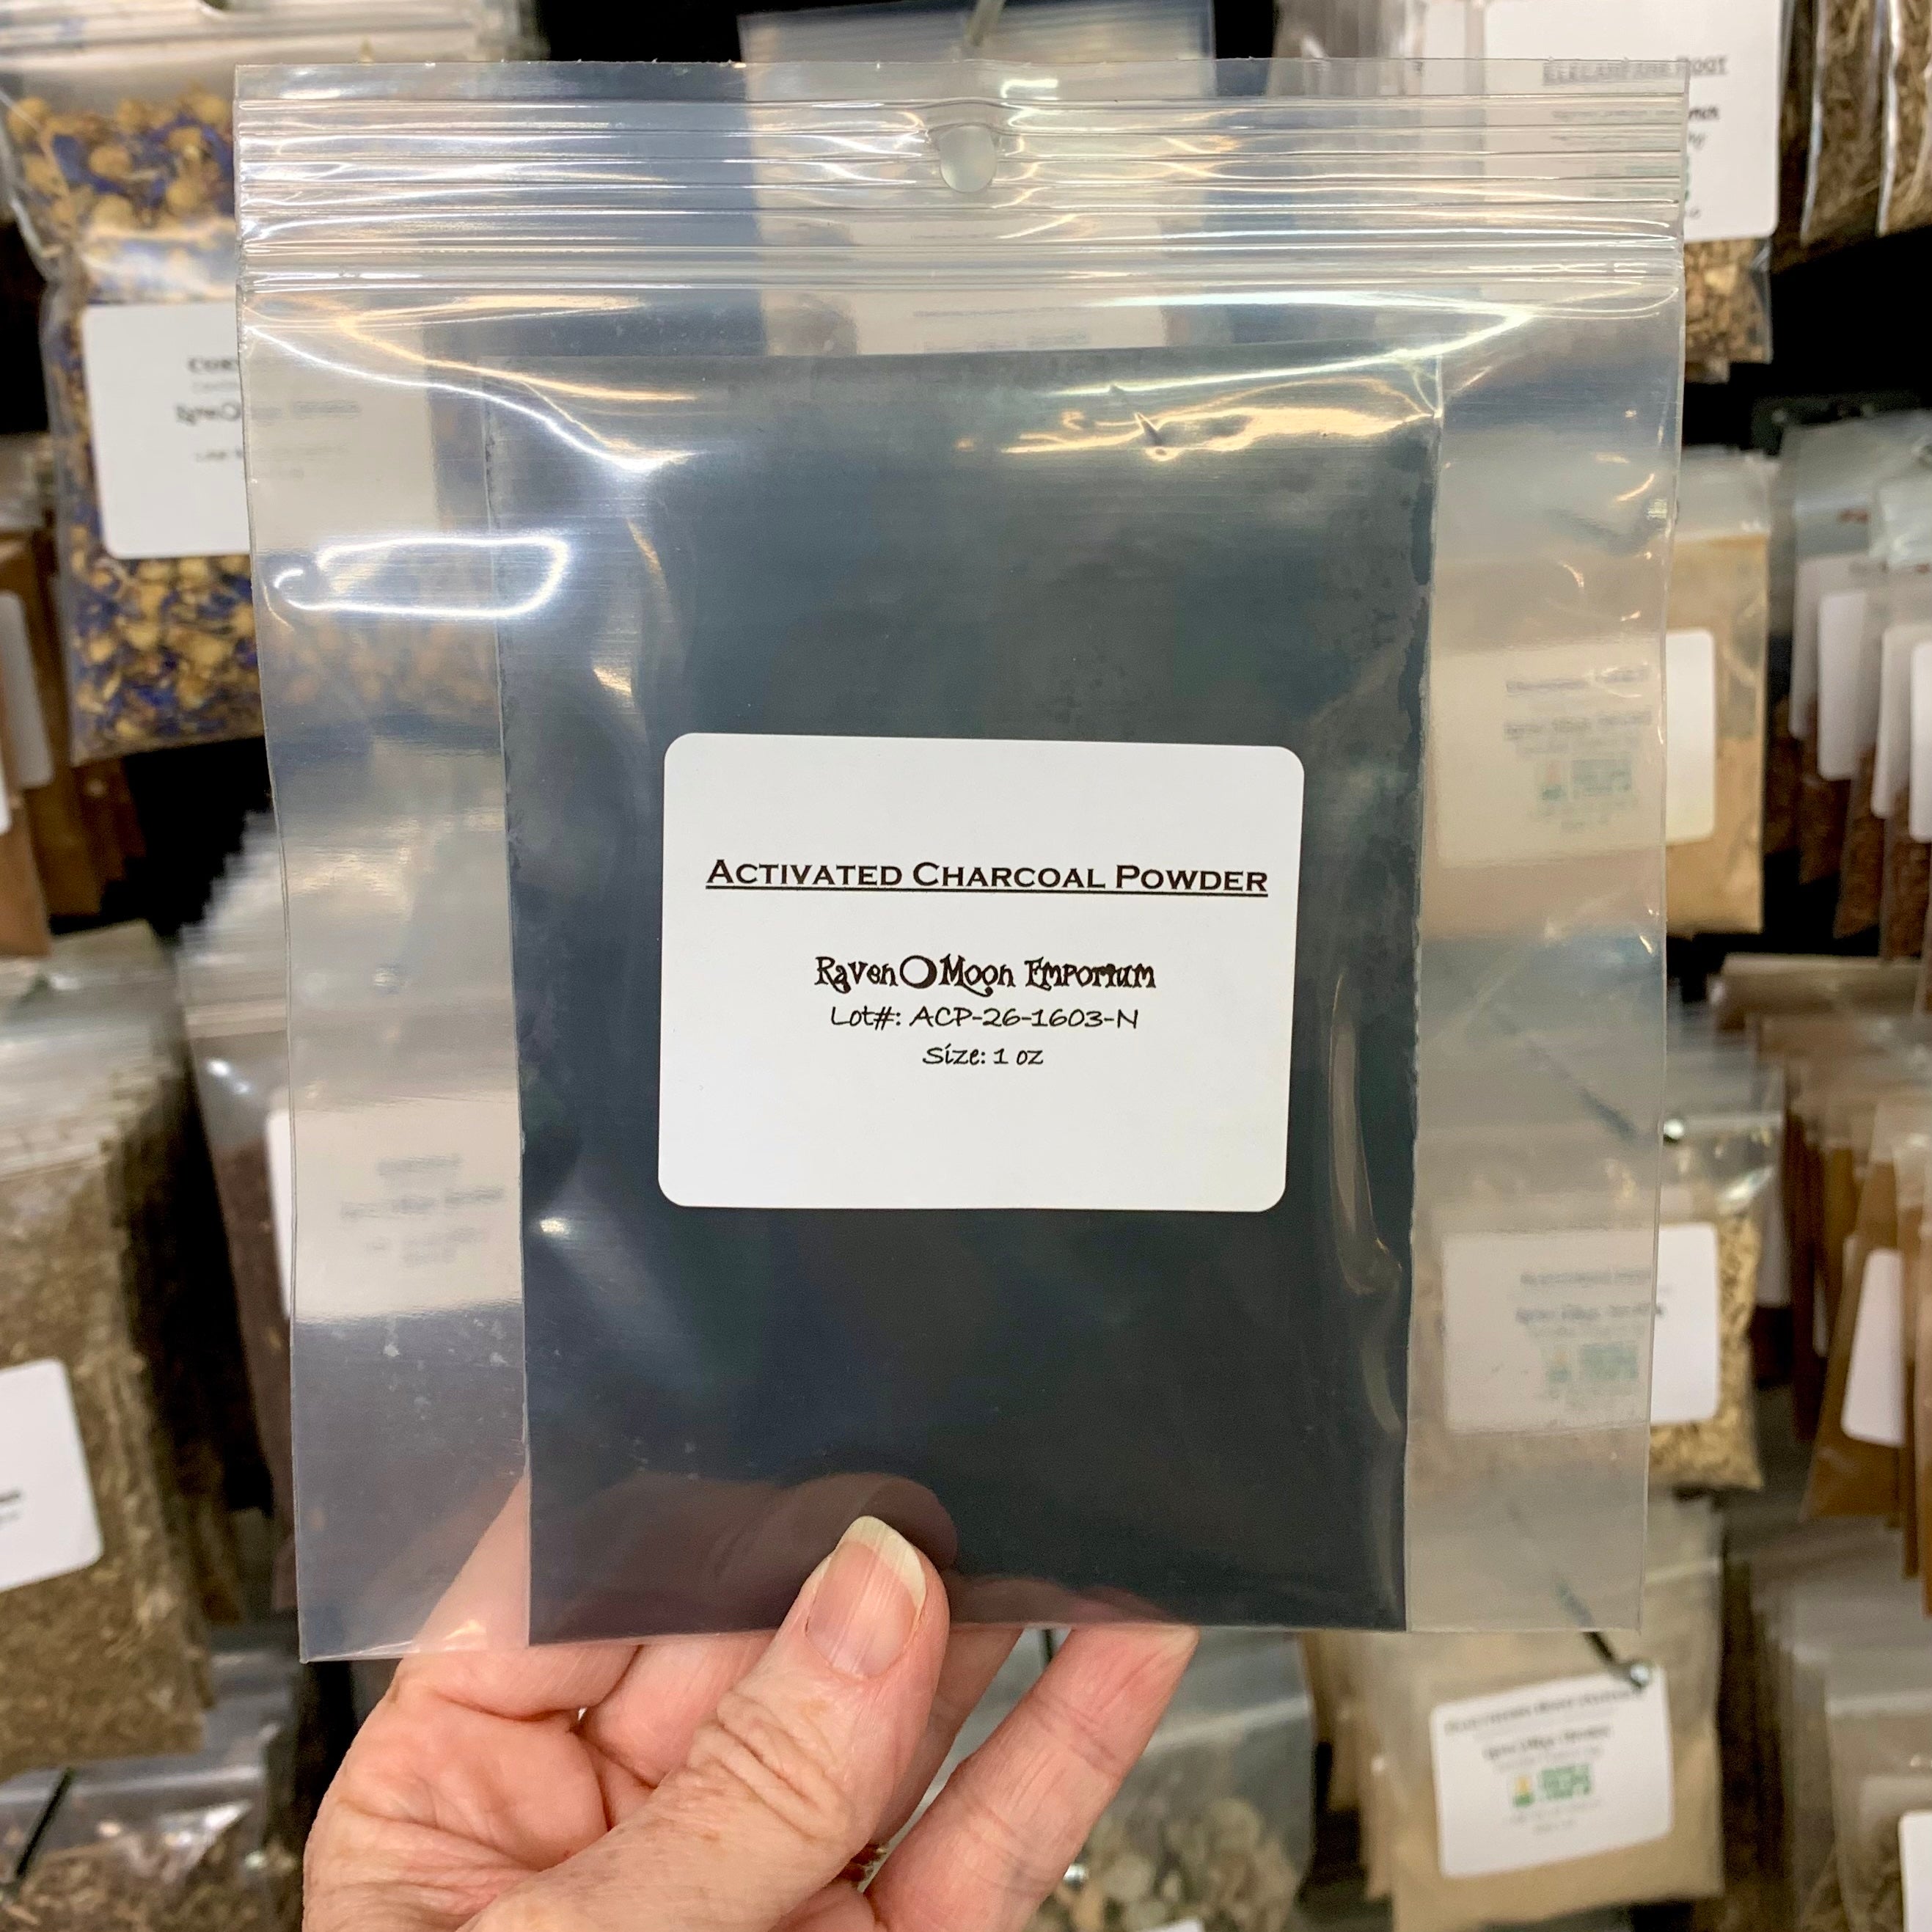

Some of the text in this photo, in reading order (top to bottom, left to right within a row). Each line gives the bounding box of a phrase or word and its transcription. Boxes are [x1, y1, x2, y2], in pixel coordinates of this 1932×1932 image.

[706, 859, 1268, 892] ACTIVATED CHARCOAL POWDER
[814, 953, 1157, 998] Raven Moon Emporium
[830, 1005, 1138, 1031] Lot#: ACP-26-1603-N
[922, 1042, 1044, 1066] Size: 1 oz
